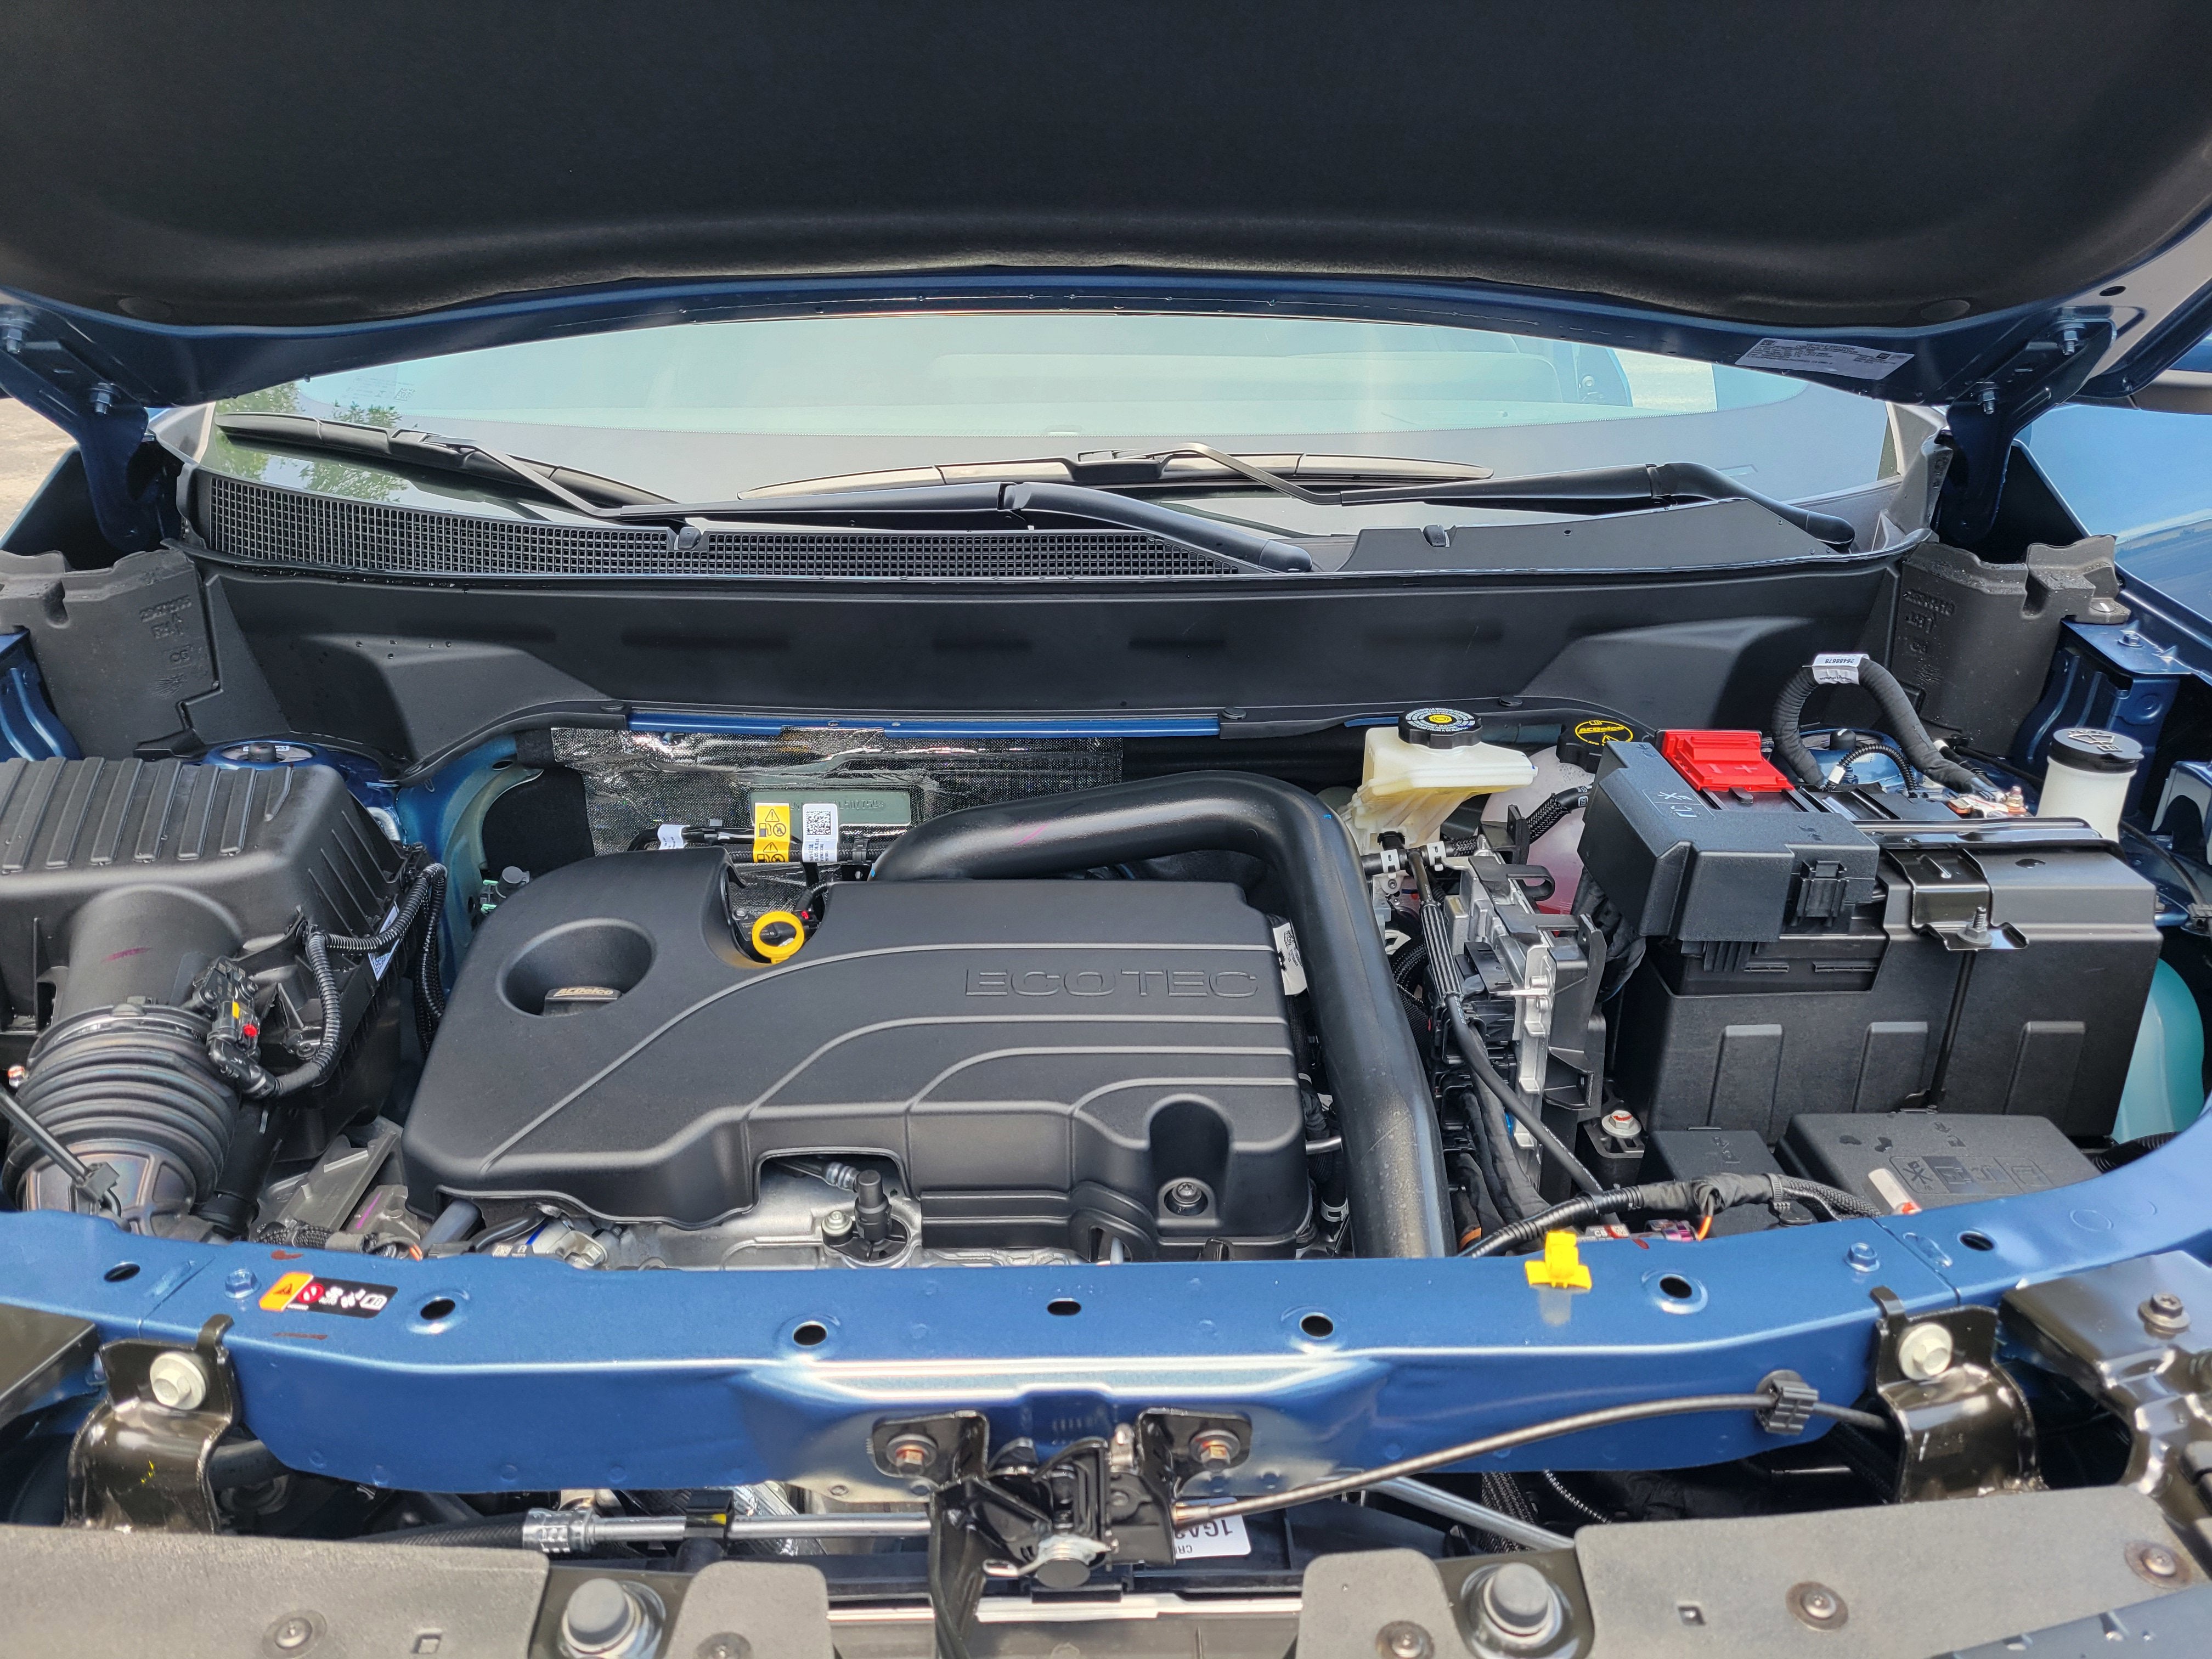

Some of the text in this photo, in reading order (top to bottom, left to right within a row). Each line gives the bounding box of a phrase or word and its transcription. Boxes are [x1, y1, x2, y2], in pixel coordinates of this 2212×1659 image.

[965, 968, 1259, 998] ECOTEC
[319, 1296, 337, 1306] AUTO
[1176, 1545, 1193, 1554] CR
